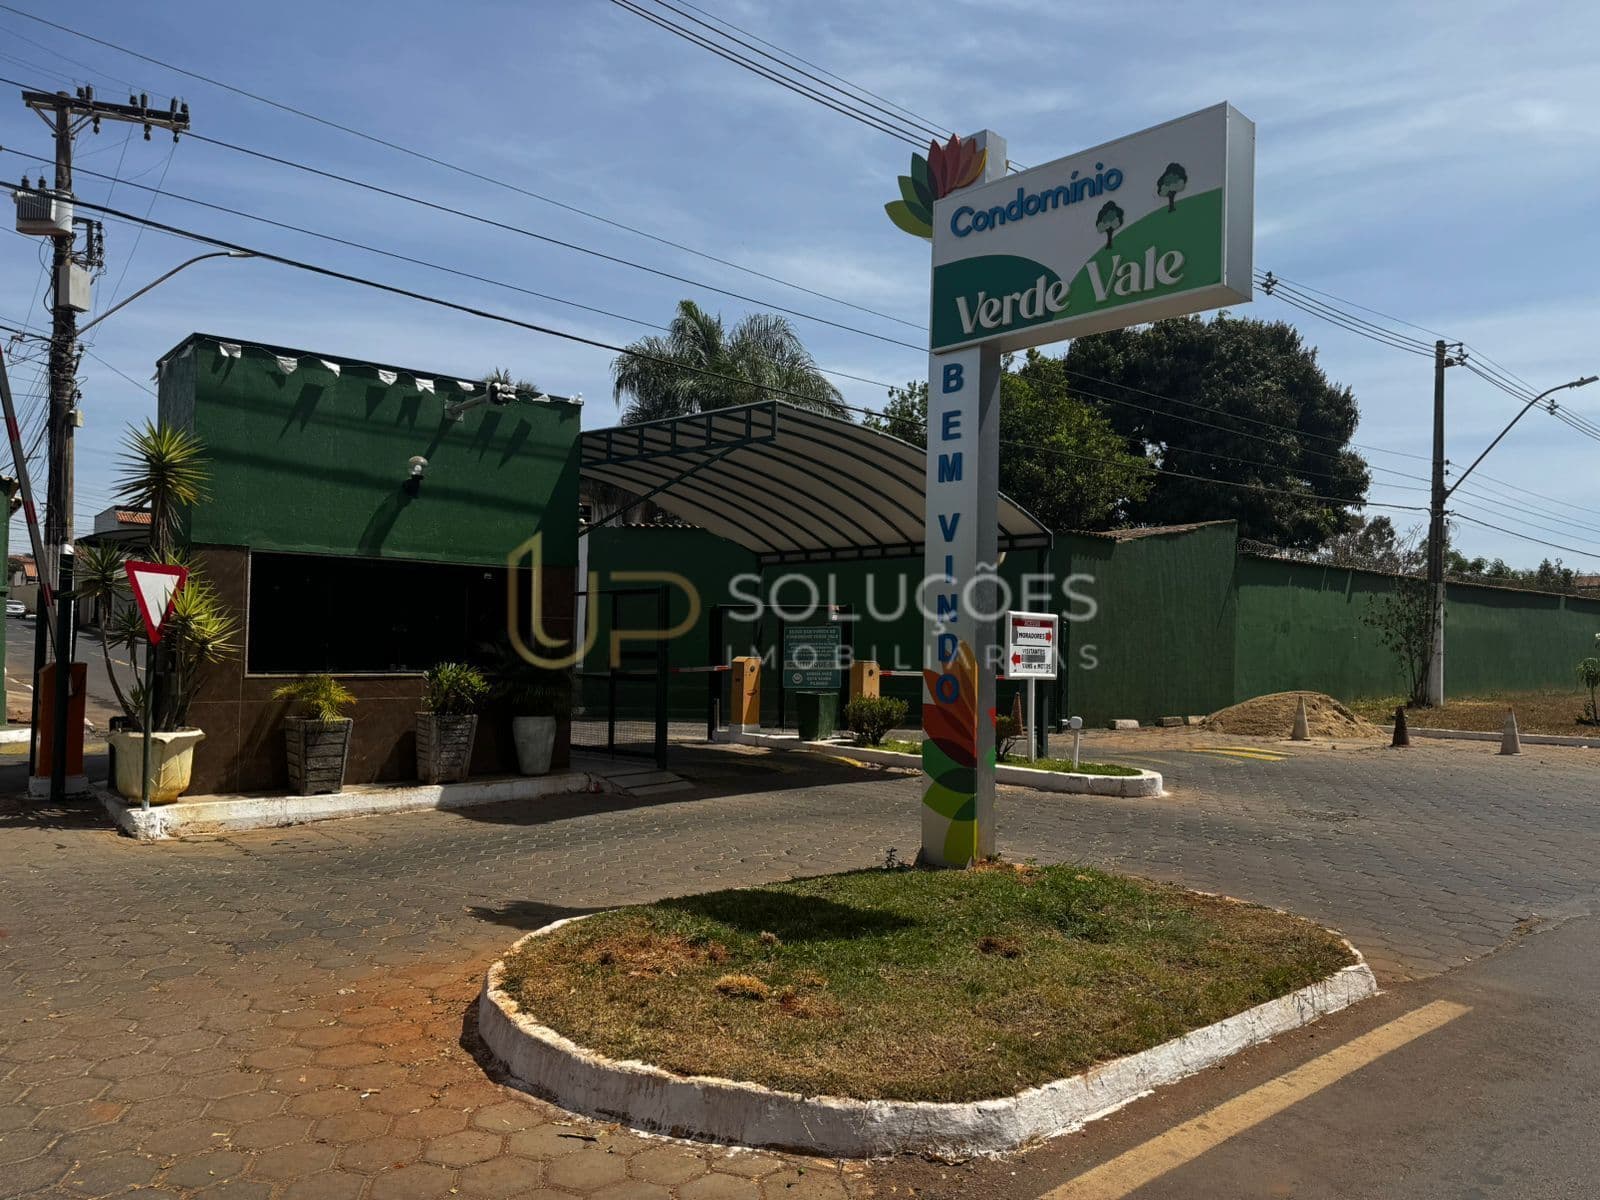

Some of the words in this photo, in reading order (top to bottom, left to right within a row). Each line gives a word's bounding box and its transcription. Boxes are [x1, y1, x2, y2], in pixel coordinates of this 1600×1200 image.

[951, 163, 1124, 237] Condomínio
[956, 275, 1072, 334] Verde
[1086, 247, 1185, 302] Vale
[938, 363, 964, 483] BEM
[936, 512, 960, 704] VINDO
